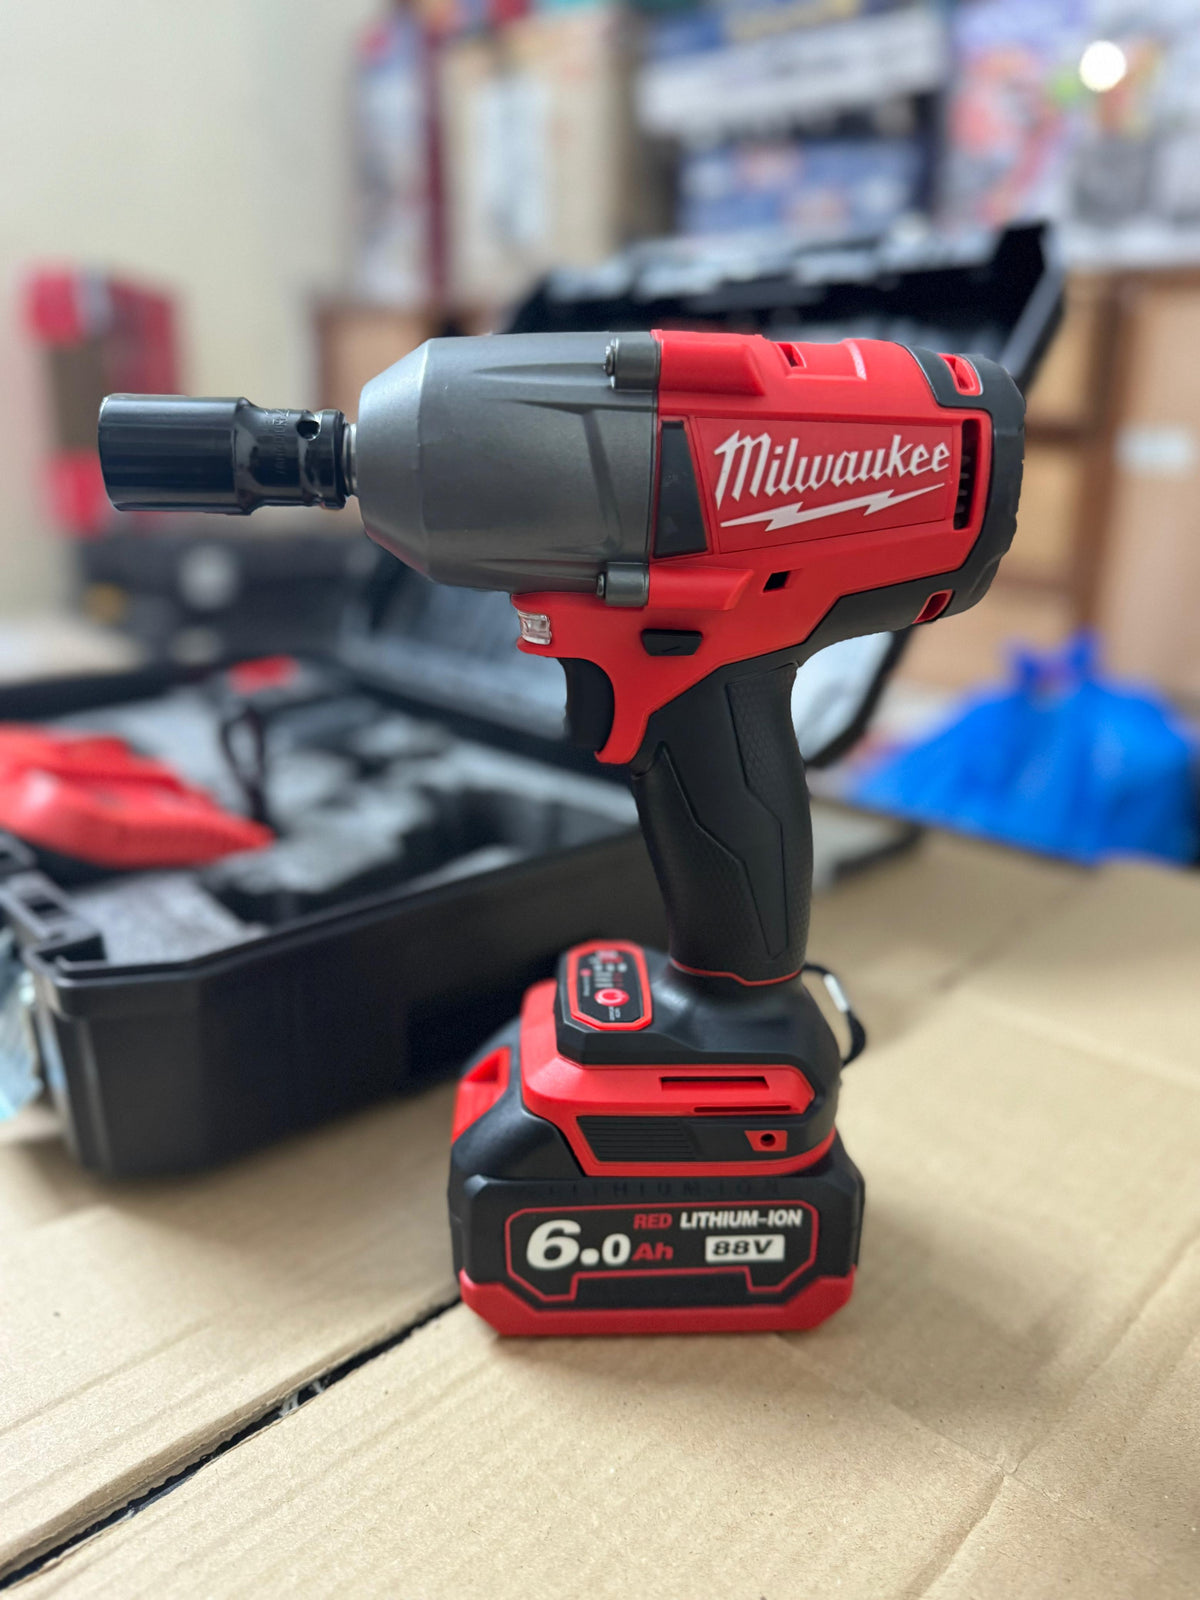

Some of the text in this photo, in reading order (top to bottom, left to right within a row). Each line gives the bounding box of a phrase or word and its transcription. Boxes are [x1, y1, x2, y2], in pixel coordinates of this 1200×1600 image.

[714, 430, 950, 511] Milwaukee
[633, 1209, 802, 1229] RED LITHIUM-ION
[526, 1219, 674, 1270] 6.0 Ah
[713, 1240, 773, 1256] 88V
